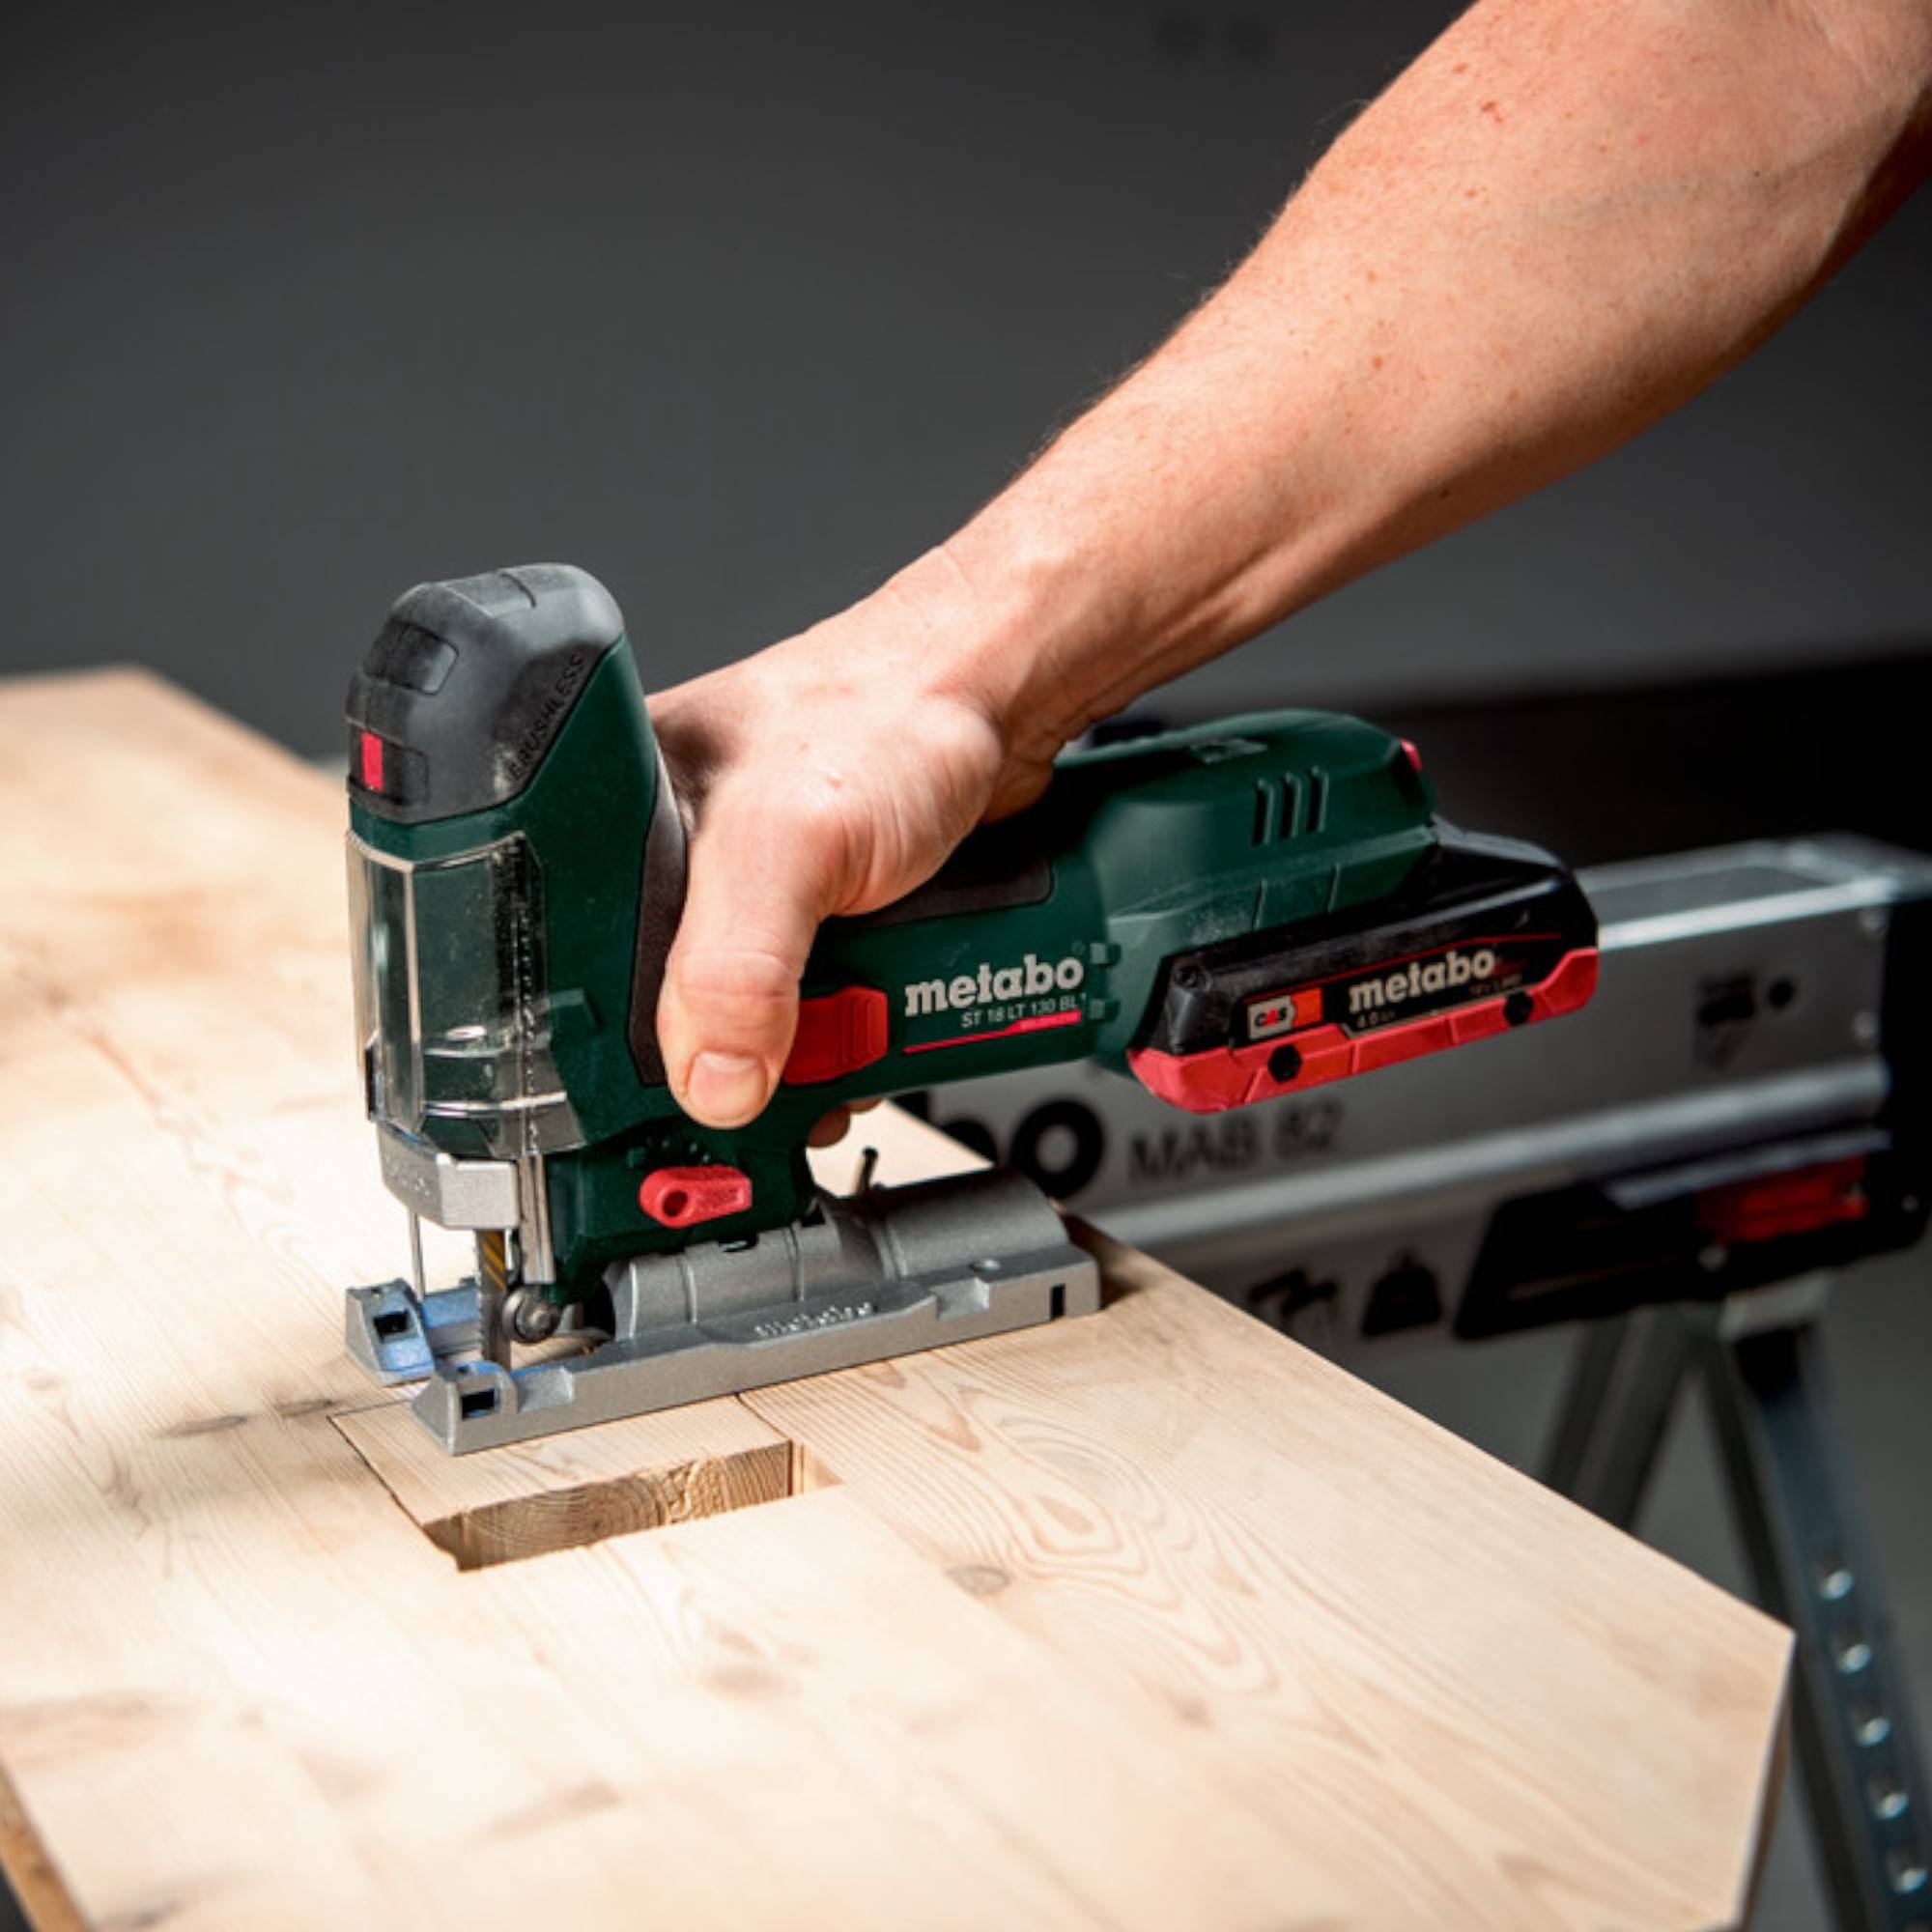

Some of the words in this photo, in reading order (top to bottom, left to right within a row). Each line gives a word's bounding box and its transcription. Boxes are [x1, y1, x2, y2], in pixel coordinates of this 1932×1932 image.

[904, 953, 1085, 1017] metabo
[1008, 1003, 1025, 1020] LT
[1349, 950, 1496, 1013] metabo
[1127, 1112, 1261, 1186] MAB
